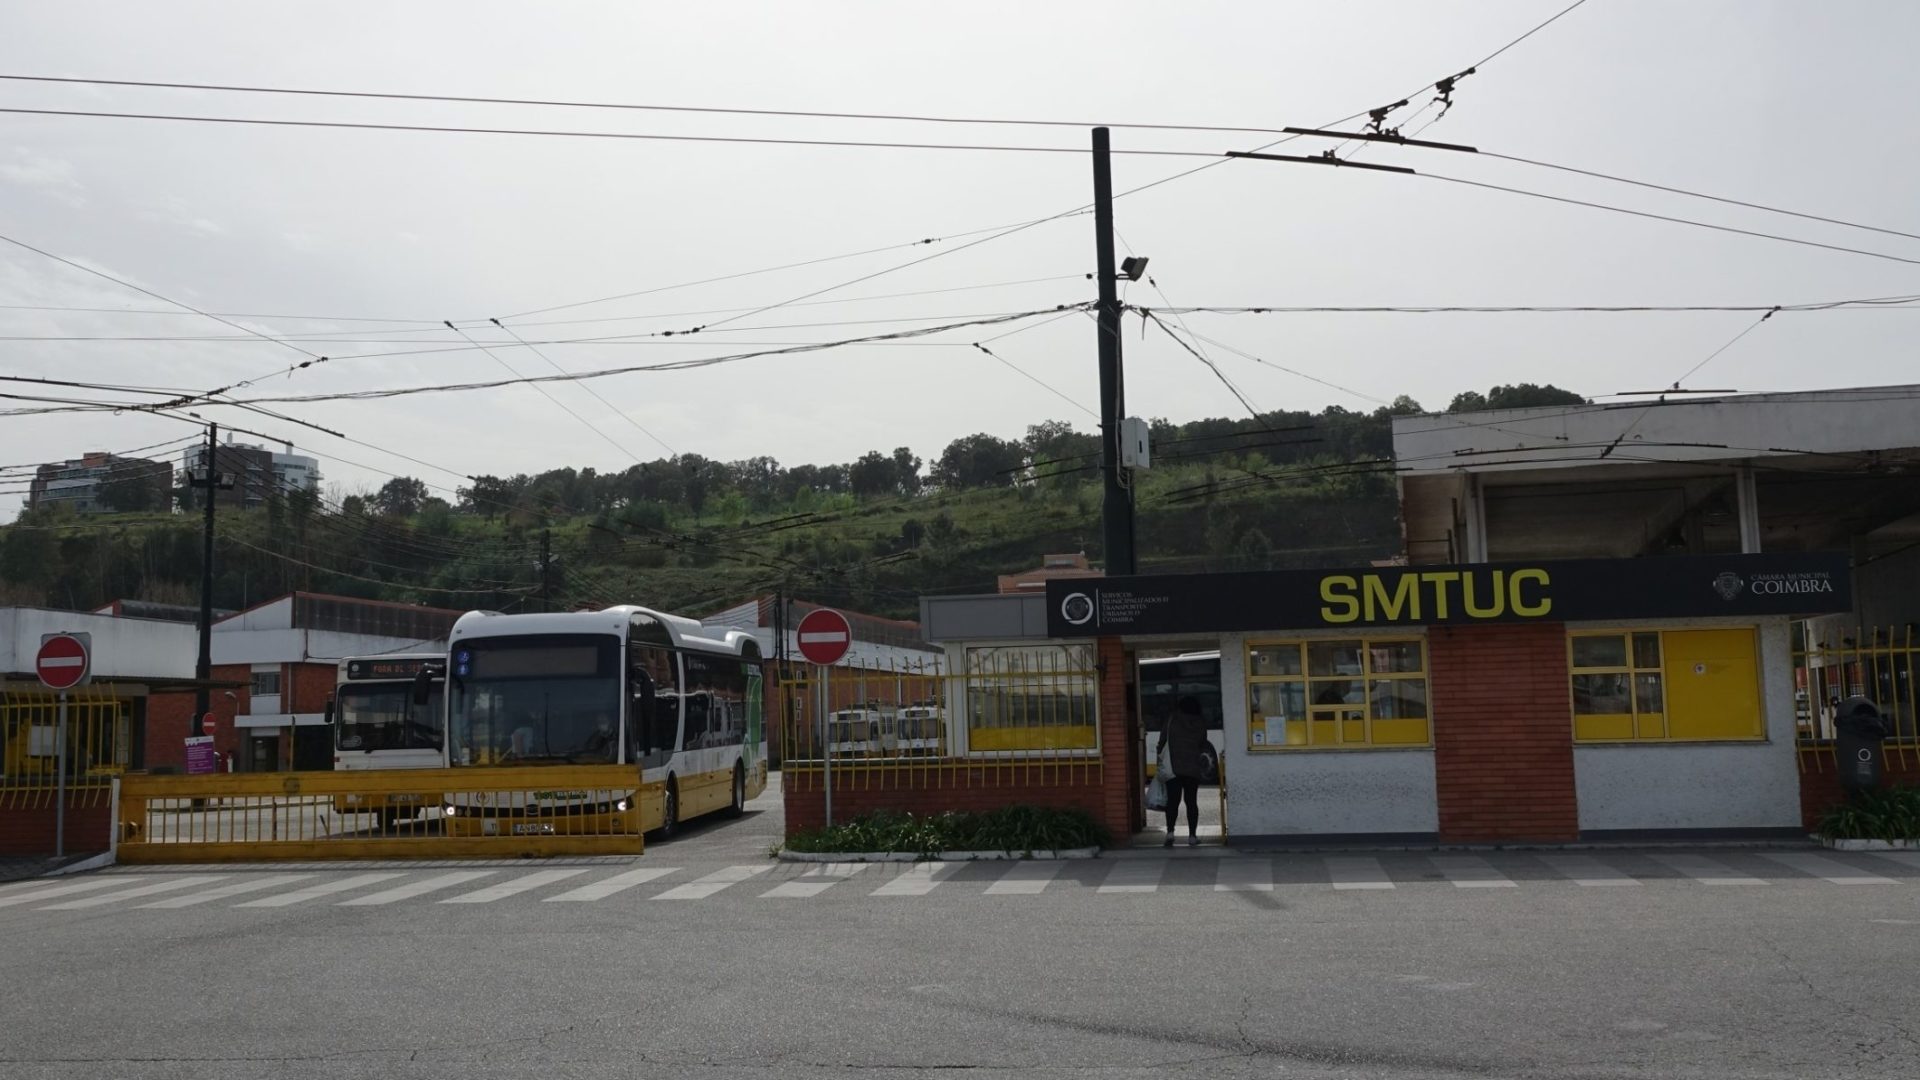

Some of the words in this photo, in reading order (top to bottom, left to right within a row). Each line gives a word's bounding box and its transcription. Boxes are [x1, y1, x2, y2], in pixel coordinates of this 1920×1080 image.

[1787, 572, 1831, 580] MUNICIPAL
[1751, 580, 1833, 594] COIMBRA
[1319, 568, 1551, 623] SMTUC
